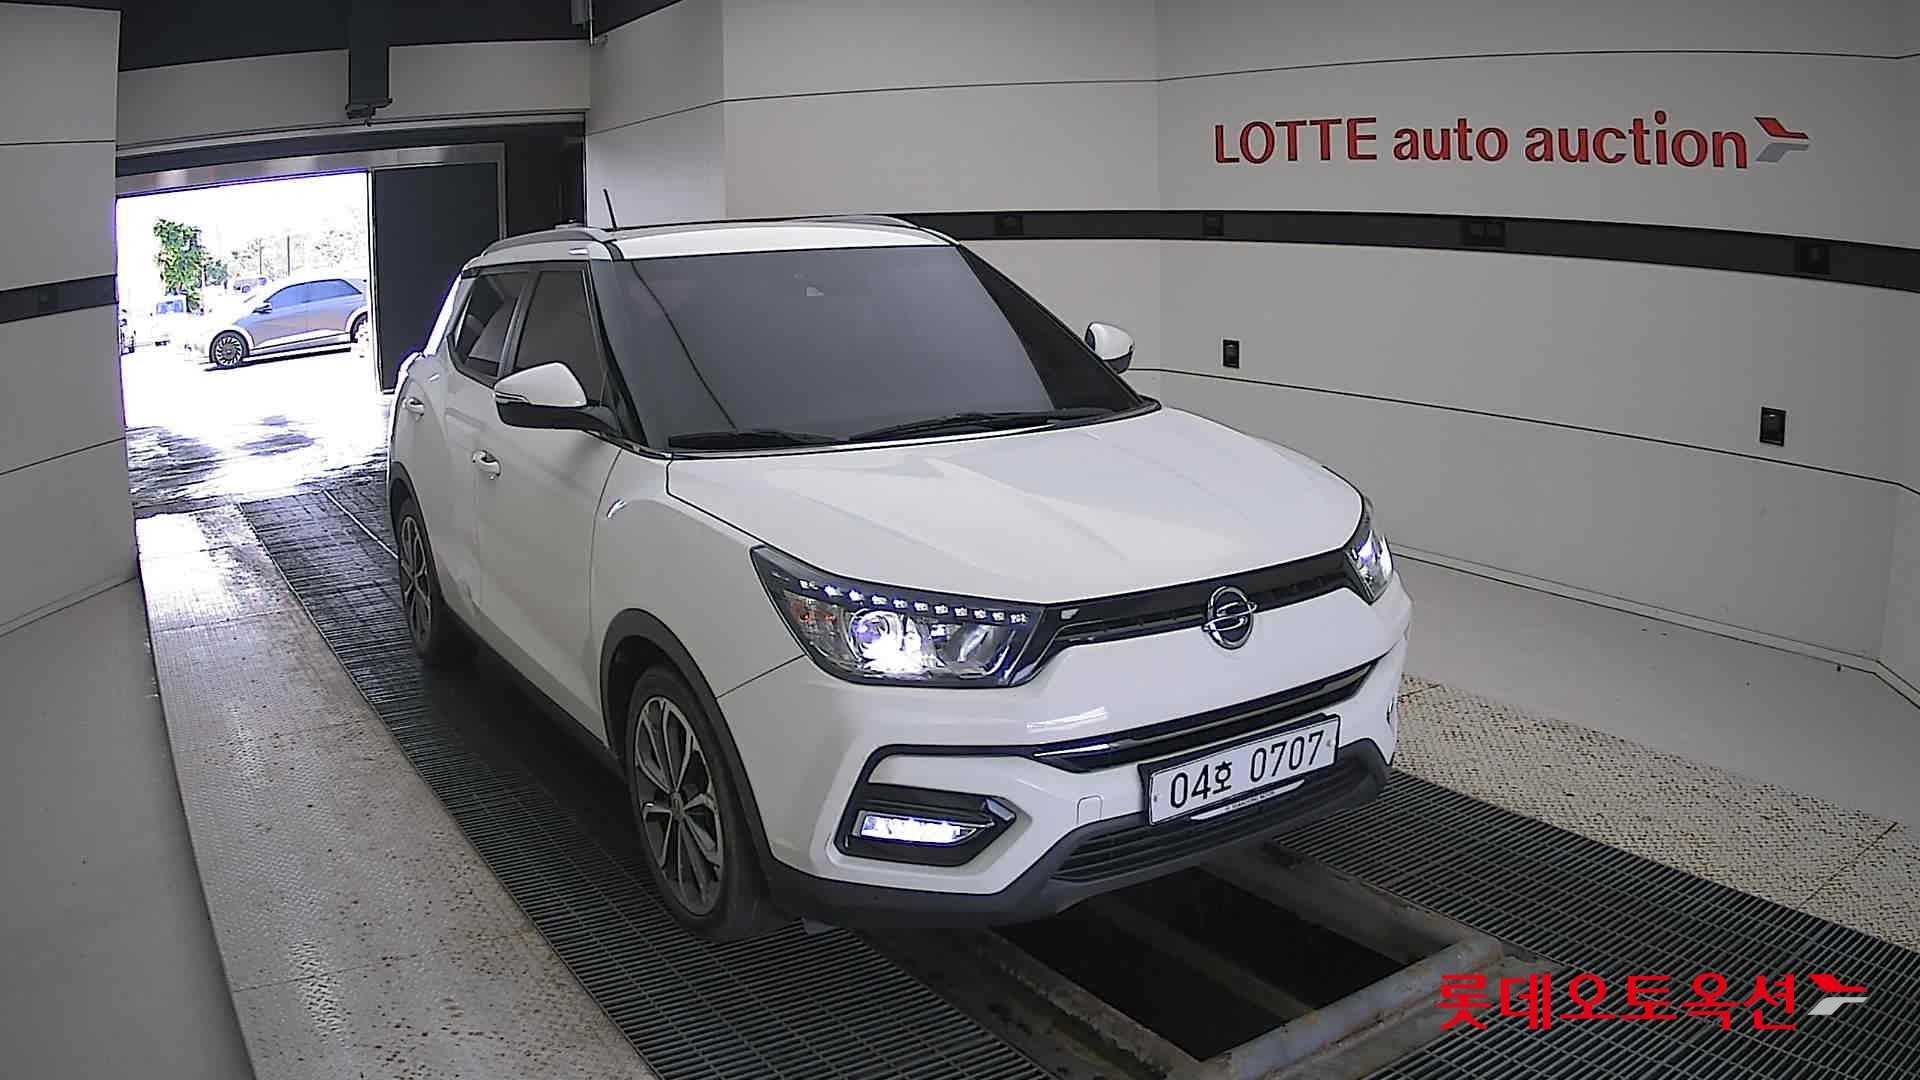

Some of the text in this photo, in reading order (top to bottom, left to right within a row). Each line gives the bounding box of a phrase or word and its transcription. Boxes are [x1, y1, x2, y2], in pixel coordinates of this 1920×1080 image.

[1214, 110, 1748, 169] LOTTE auto auction
[1170, 761, 1232, 808] 04호
[1250, 730, 1324, 782] 0707
